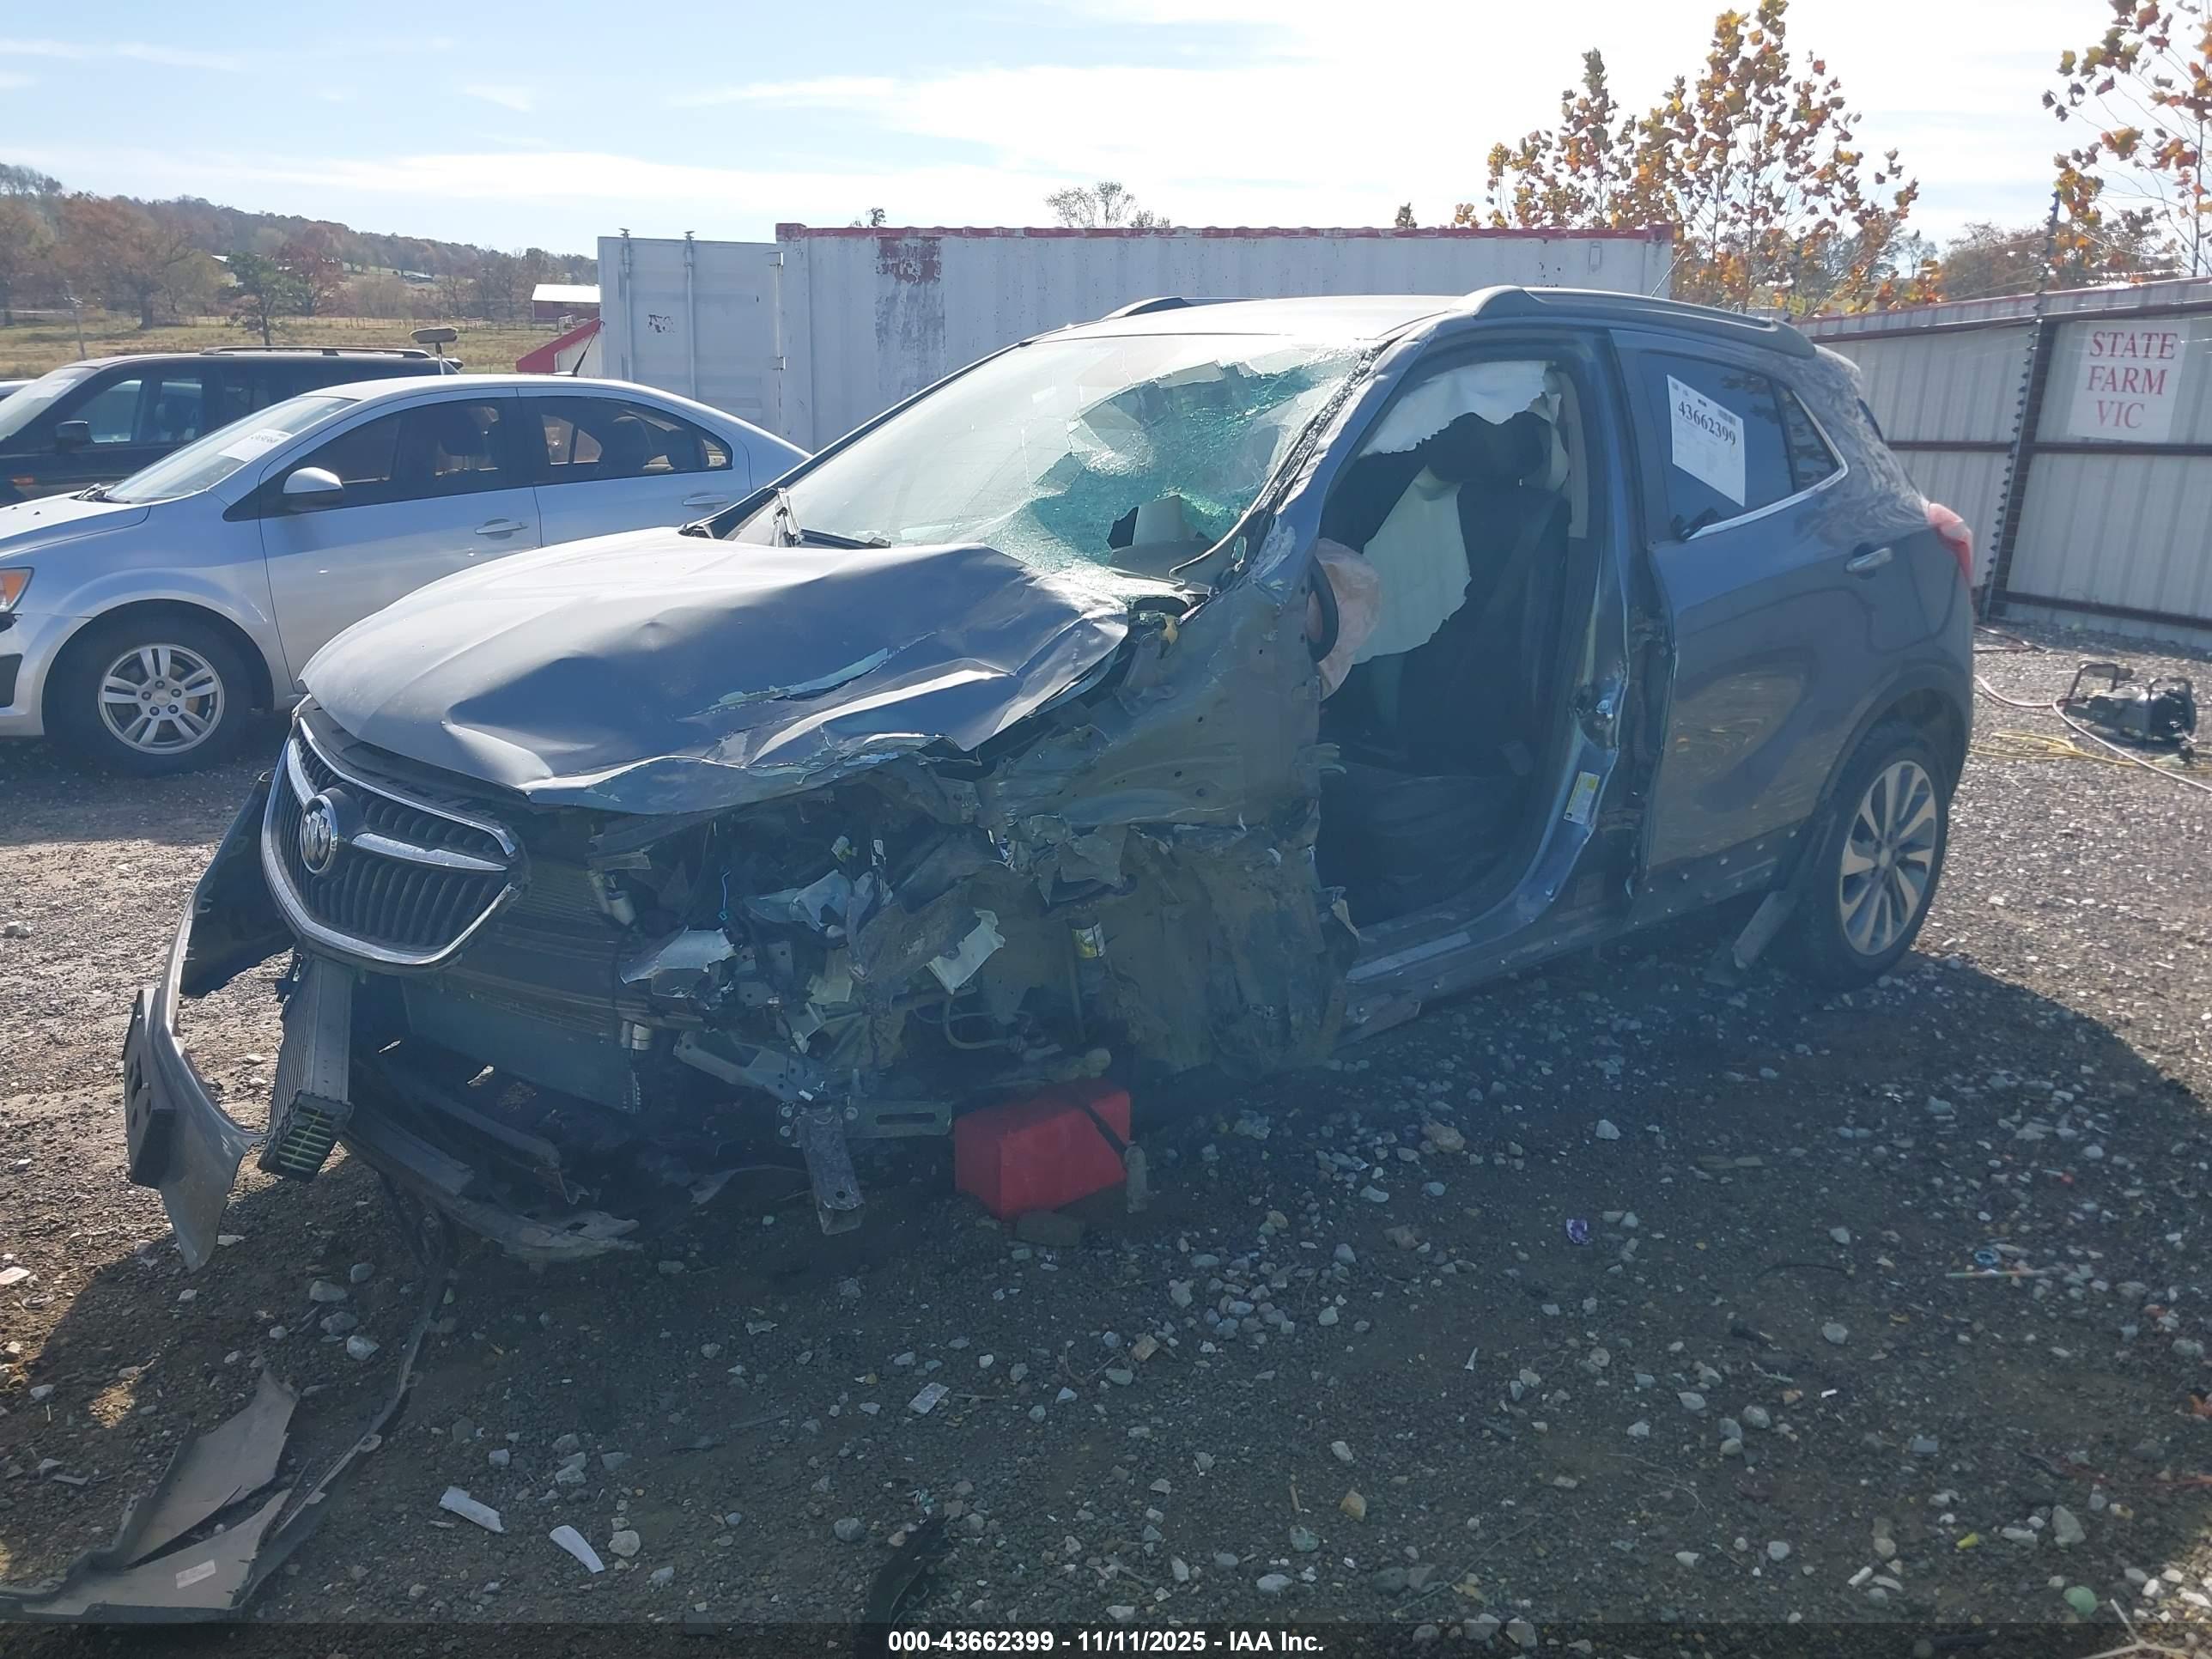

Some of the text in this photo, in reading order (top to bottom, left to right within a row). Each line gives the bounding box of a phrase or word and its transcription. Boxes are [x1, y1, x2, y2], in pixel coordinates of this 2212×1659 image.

[2089, 330, 2179, 360] STATE
[2086, 365, 2169, 396] FARM
[1678, 401, 1736, 446] 43662399
[2096, 399, 2146, 429] VIC
